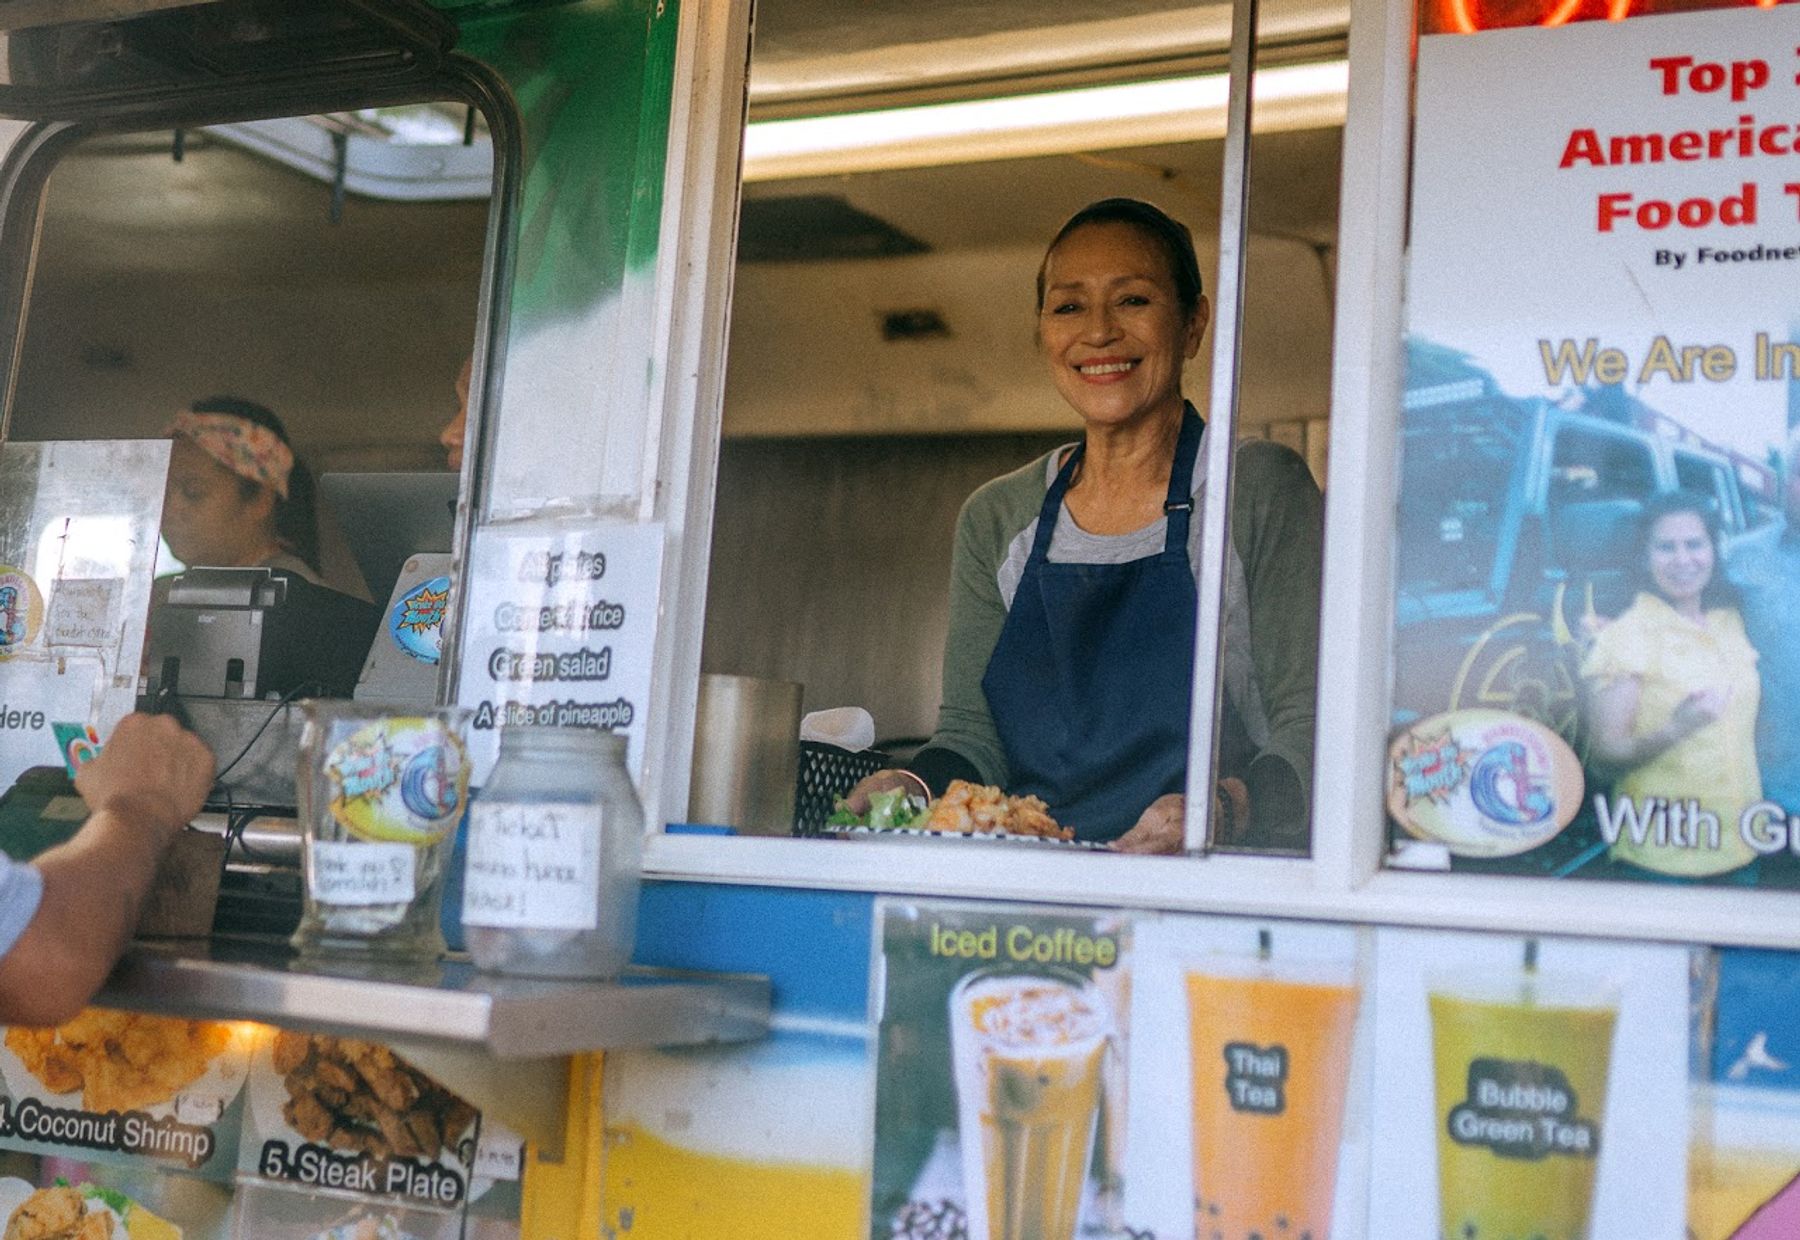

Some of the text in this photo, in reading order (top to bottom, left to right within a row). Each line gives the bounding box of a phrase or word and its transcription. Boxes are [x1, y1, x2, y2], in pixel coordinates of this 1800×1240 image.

[1650, 55, 1770, 102] Top
[1558, 114, 1800, 169] Americ
[1597, 182, 1757, 232] Food
[1655, 242, 1800, 270] By Foodne
[1538, 337, 1630, 386] We
[1635, 334, 1738, 384] Are
[590, 602, 623, 630] rice
[490, 648, 610, 679] Green salad
[477, 702, 632, 729] A slice of pineapple
[1592, 792, 1721, 850] With
[931, 922, 1116, 967] Iced Coffee
[1231, 1047, 1280, 1077] Thai
[1232, 1079, 1277, 1108] Tea
[1477, 1078, 1568, 1114] Bubble
[20, 1105, 117, 1145] Coconut
[123, 1117, 209, 1161] Shrimp
[1456, 1109, 1591, 1149] Green Tea
[265, 1146, 459, 1202] 5. Steak Plate
